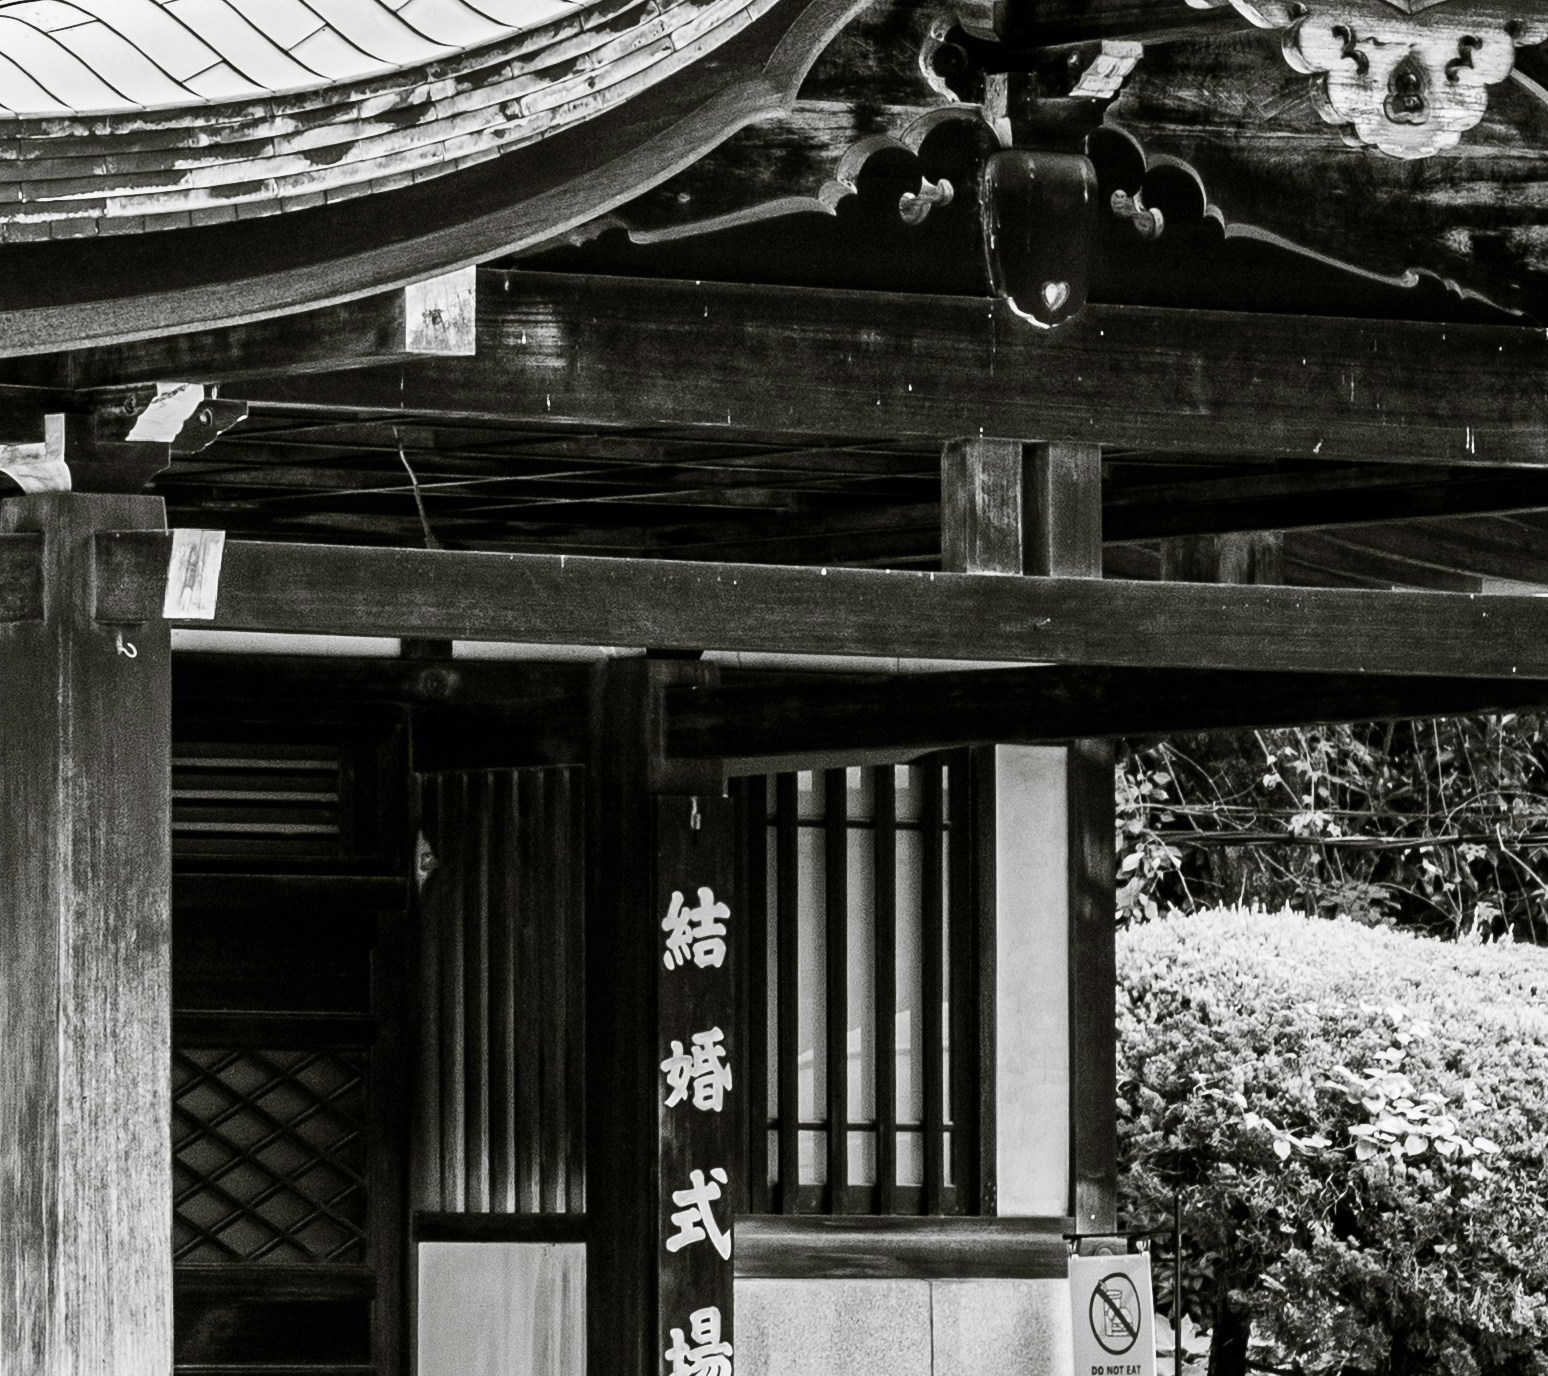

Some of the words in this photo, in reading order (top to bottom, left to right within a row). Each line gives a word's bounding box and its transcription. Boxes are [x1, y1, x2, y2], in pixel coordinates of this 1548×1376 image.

[1091, 1365, 1104, 1375] DO
[1106, 1365, 1124, 1375] NOT
[1126, 1364, 1141, 1375] EAT
